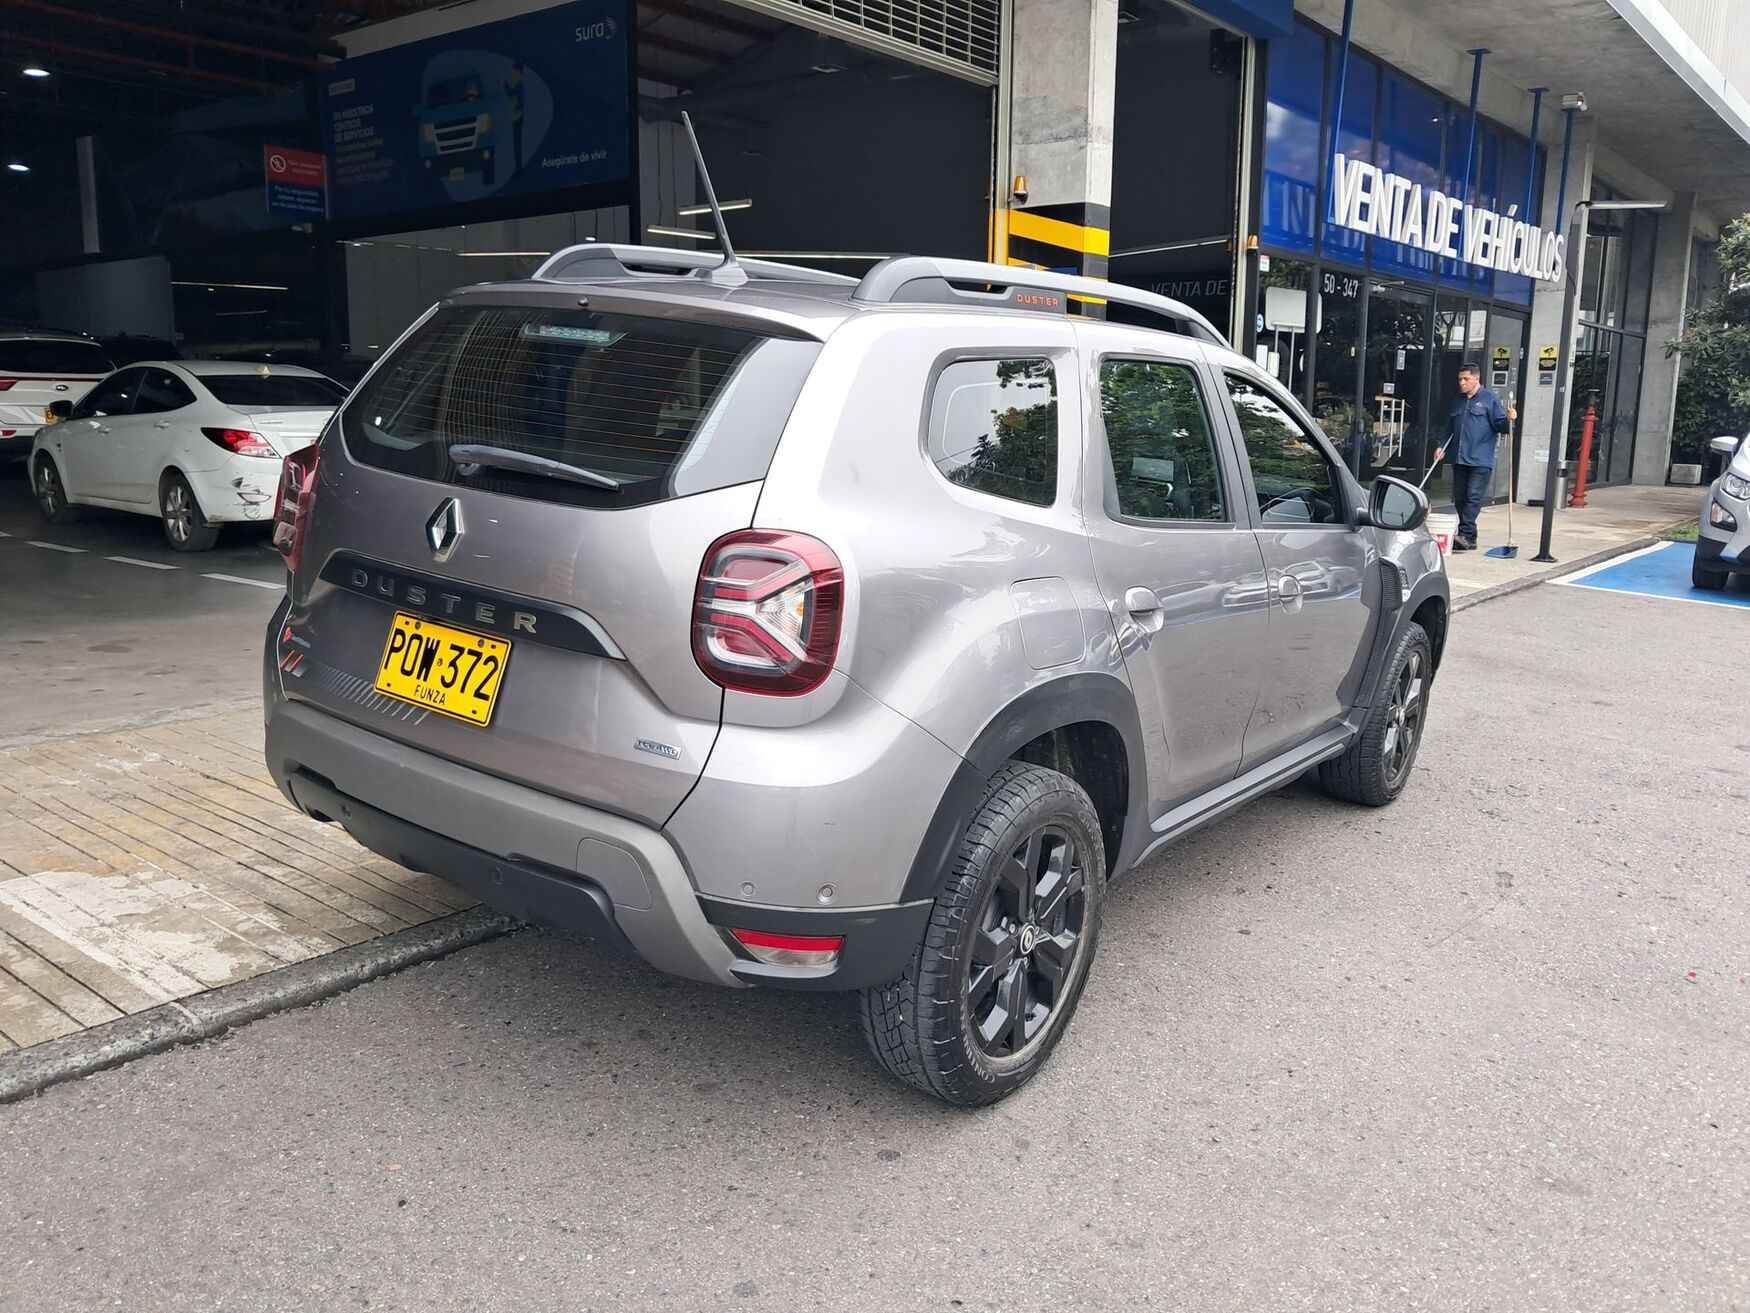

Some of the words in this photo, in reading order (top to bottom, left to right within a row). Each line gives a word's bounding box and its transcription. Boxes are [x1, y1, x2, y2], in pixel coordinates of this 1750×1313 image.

[576, 19, 604, 43] sura
[579, 151, 590, 162] de
[1334, 152, 1422, 249] VENTA
[1425, 190, 1463, 258] DE
[1464, 203, 1565, 283] VEHÍCULOS
[1151, 279, 1201, 297] VENTA
[1204, 279, 1229, 297] DE
[1324, 273, 1335, 294] 50
[1342, 277, 1359, 299] 347
[1016, 294, 1058, 306] DUSTER
[351, 568, 537, 634] DUSTER
[383, 626, 441, 682] POW
[440, 644, 501, 701] 372
[414, 684, 446, 706] FUNZA
